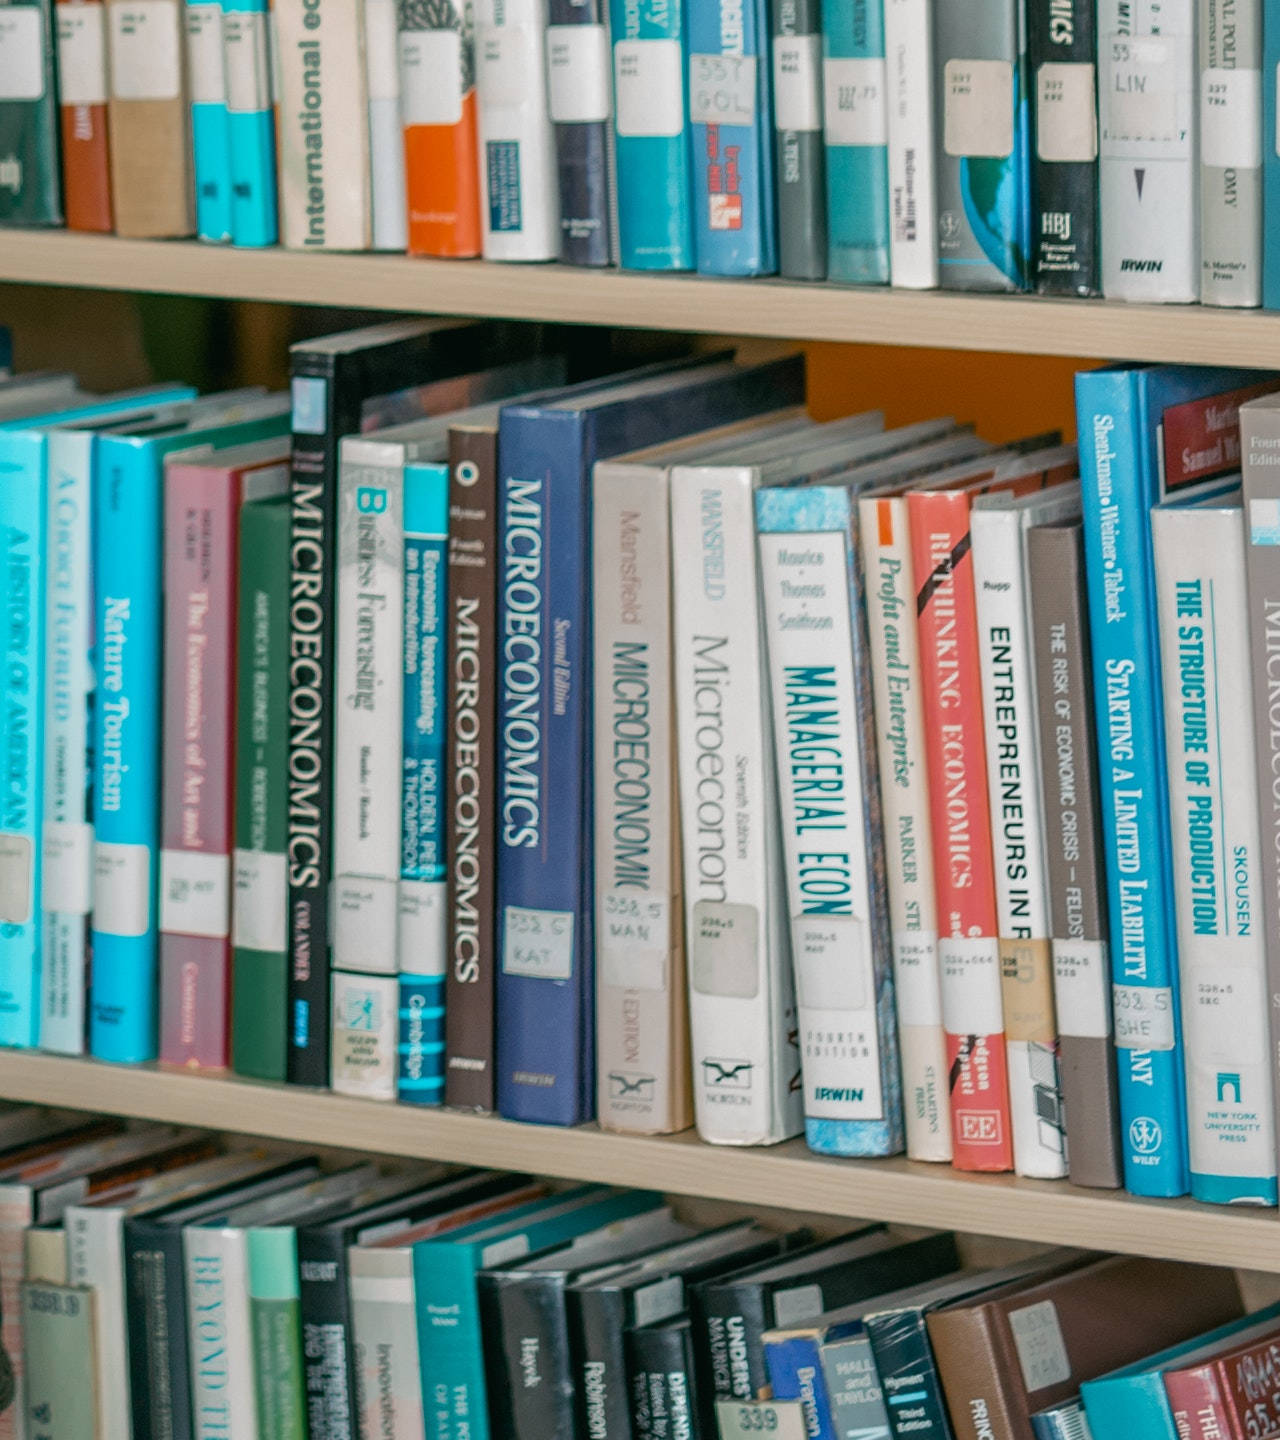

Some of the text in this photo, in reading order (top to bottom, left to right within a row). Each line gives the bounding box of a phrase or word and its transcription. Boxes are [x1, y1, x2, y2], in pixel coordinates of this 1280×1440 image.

[299, 41, 325, 246] International
[289, 474, 324, 889] MICROECONOMICS
[502, 476, 540, 849] MICROECONOMICS
[783, 665, 847, 838] MANAGERIAL
[990, 626, 1028, 919] ENTREPRENEURS IN
[1176, 579, 1218, 937] THE STRUCTURE OF PRODUCTION
[452, 598, 482, 984] MICROECONOMICS
[1231, 846, 1250, 937] SKOUSEN
[32, 1402, 50, 1424] &
[739, 1409, 778, 1432] 339
